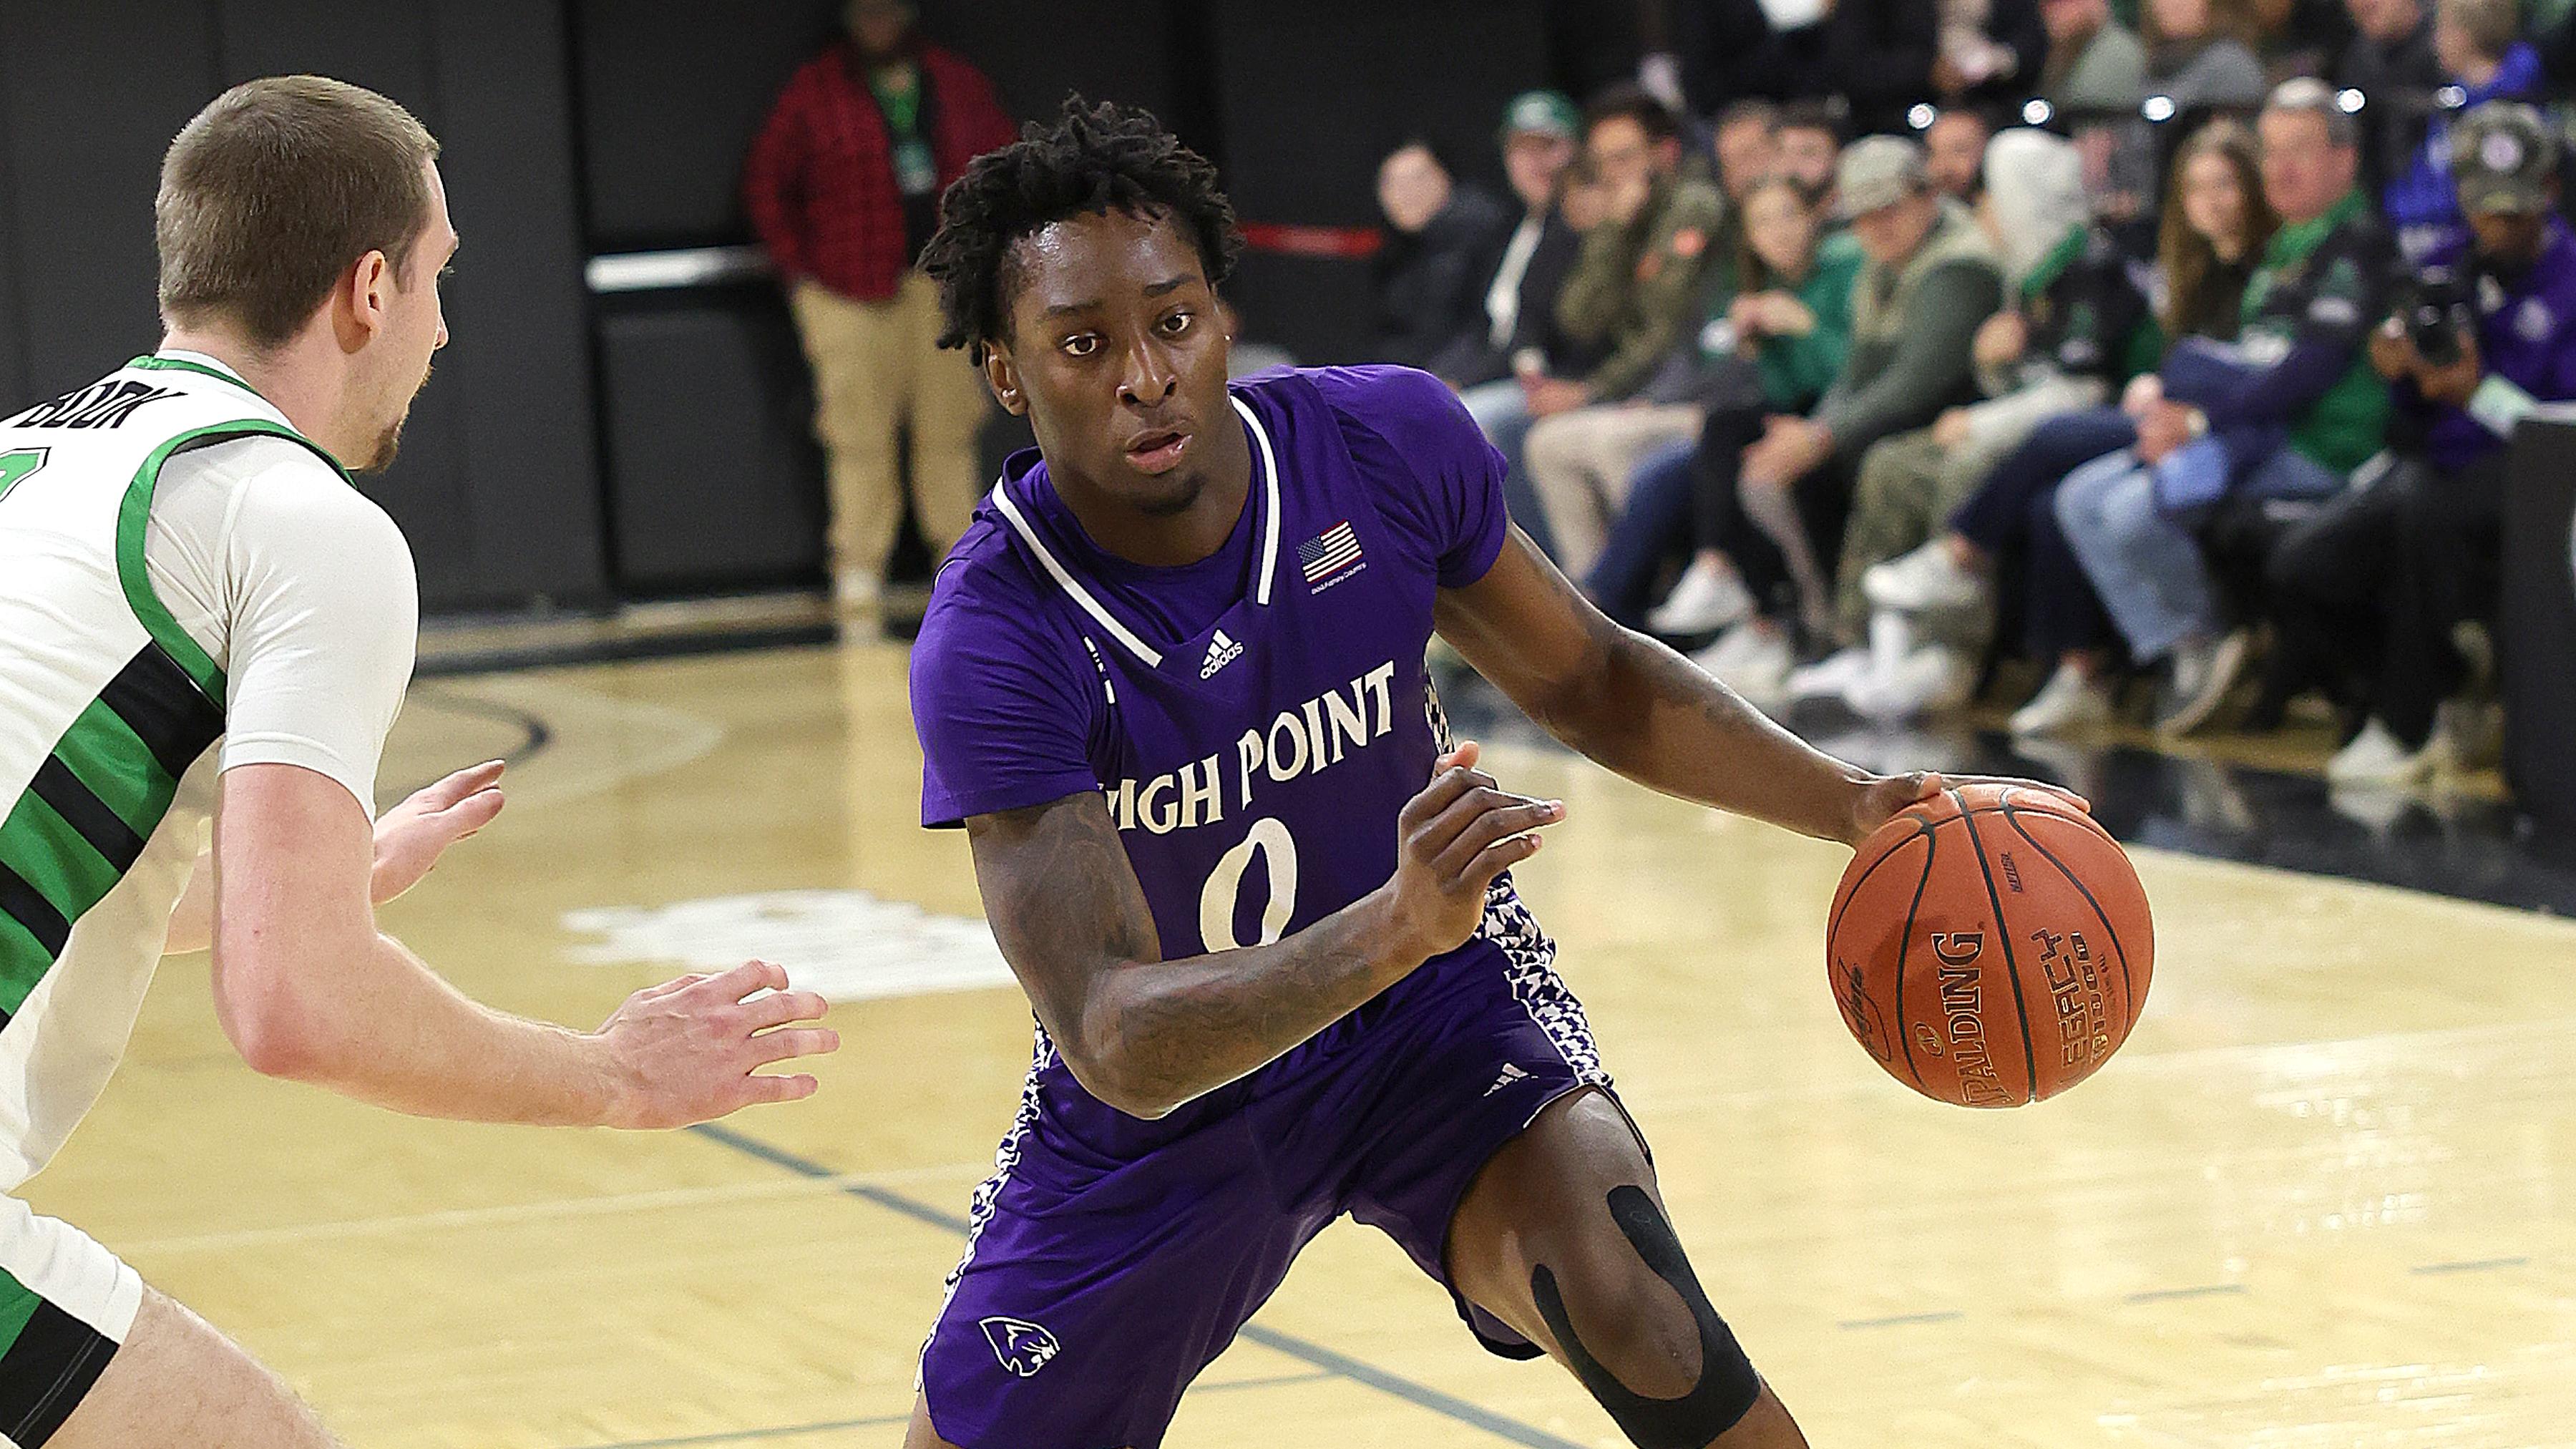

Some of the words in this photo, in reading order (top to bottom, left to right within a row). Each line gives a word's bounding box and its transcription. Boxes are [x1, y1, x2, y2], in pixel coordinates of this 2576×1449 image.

[1200, 642, 1244, 679] adidas
[1098, 753, 1224, 834] IGH
[1236, 660, 1395, 811] POINT
[1199, 817, 1297, 953] 0
[1932, 932, 2015, 1105] SPALDING
